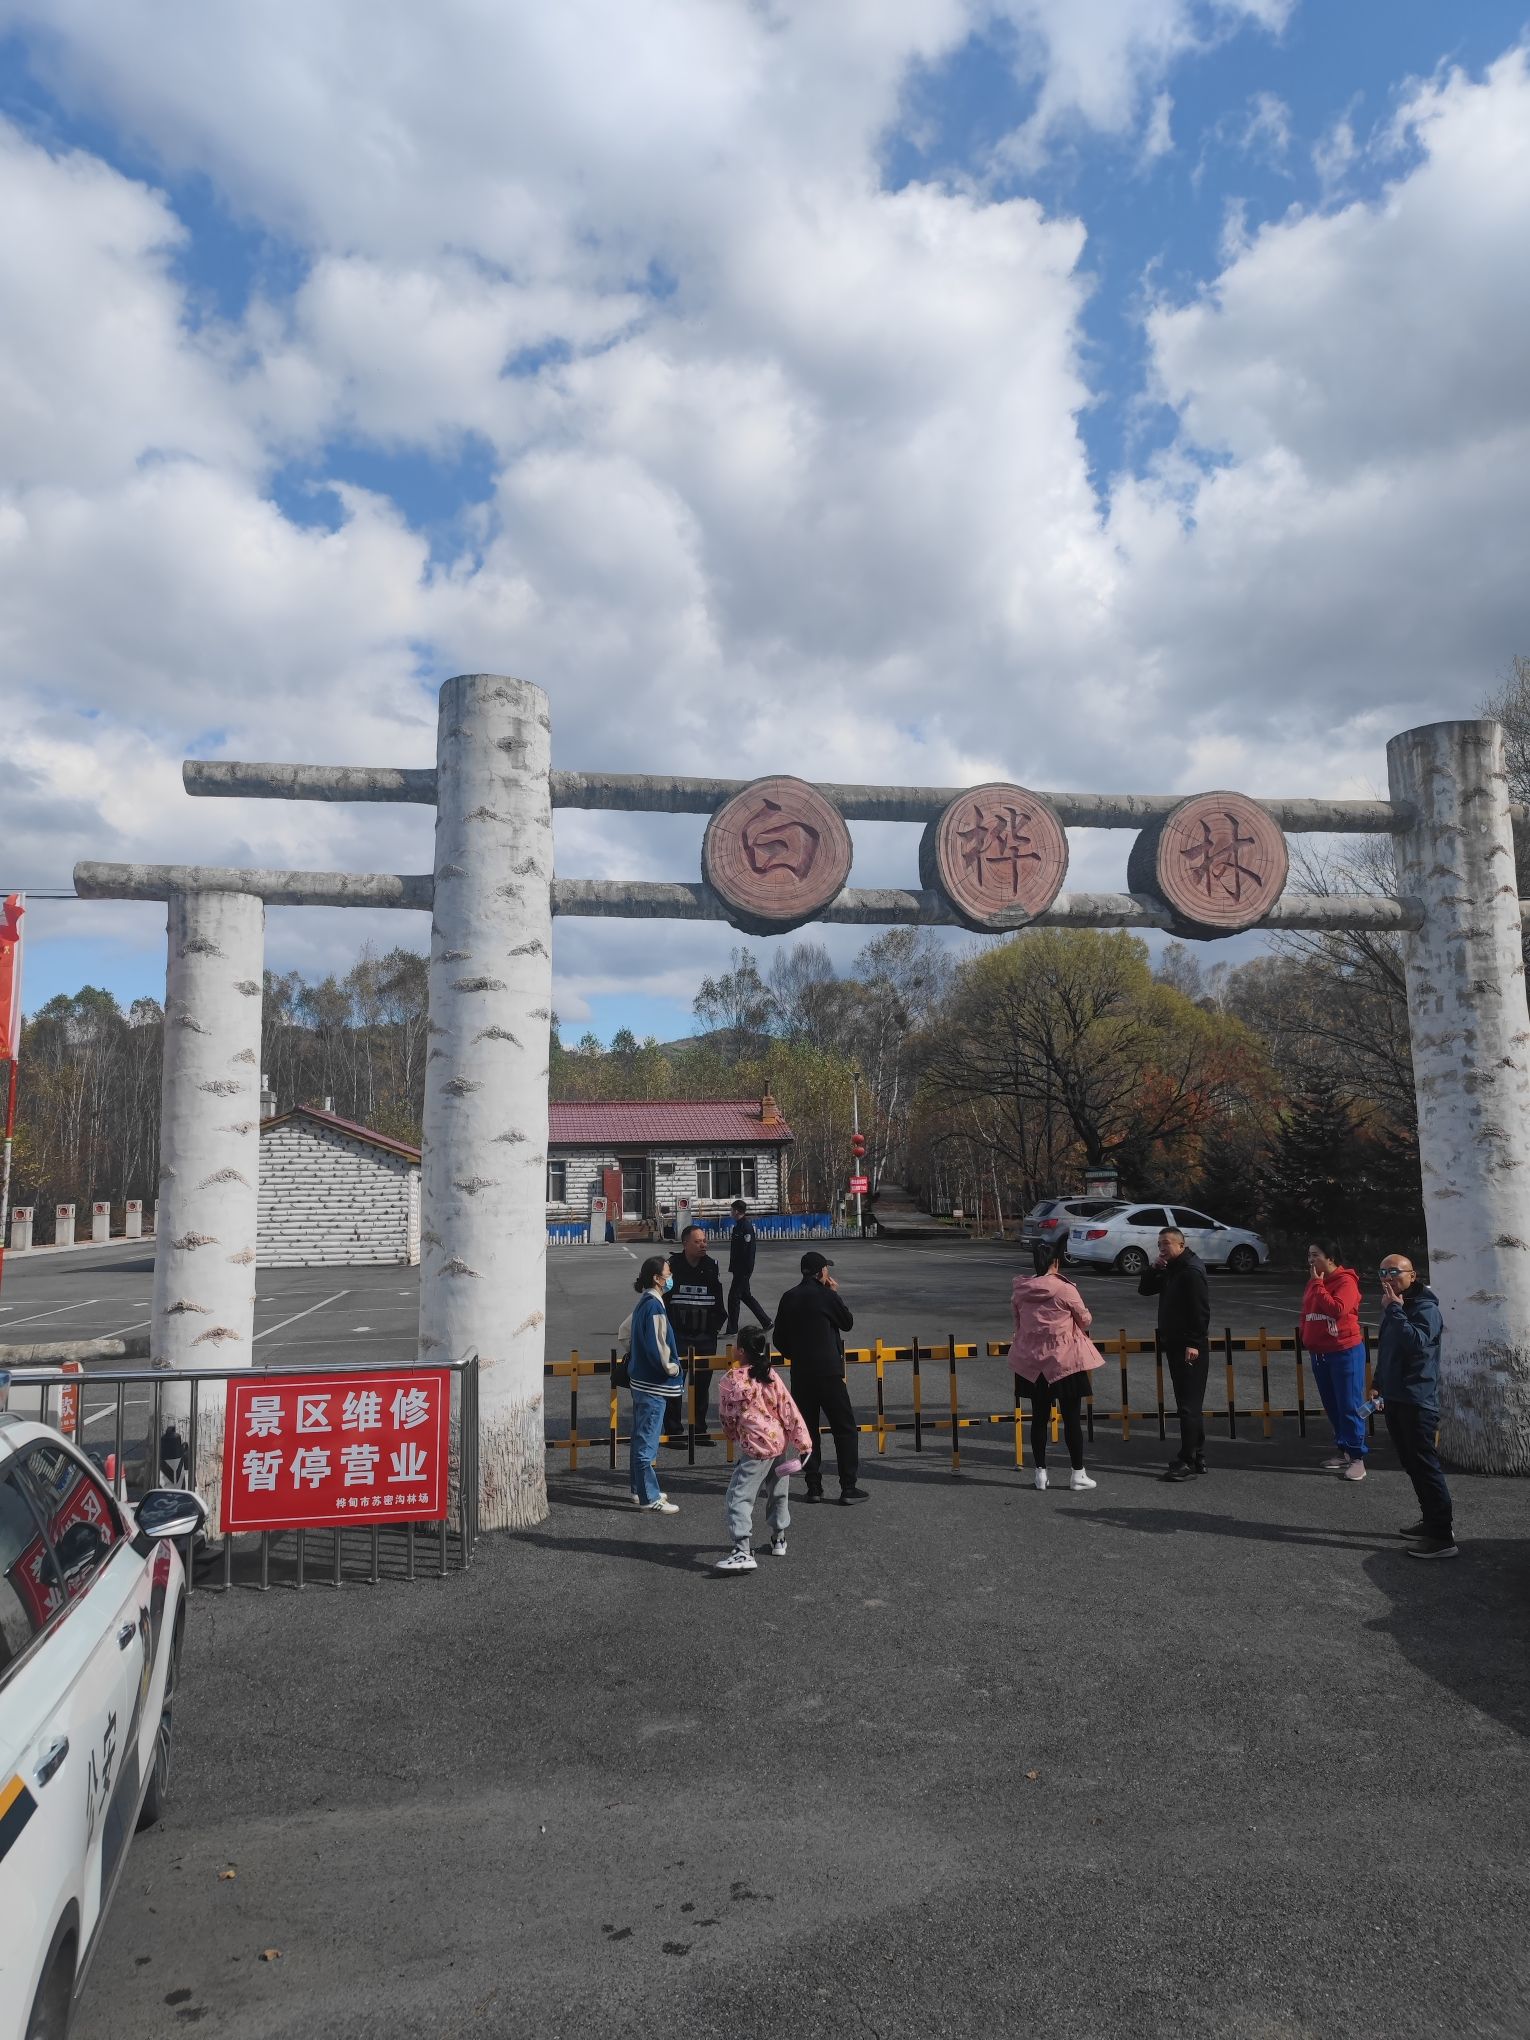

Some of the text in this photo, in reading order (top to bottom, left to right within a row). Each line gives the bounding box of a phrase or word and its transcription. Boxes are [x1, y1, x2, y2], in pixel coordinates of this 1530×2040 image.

[742, 798, 1263, 902] 白桦林
[244, 1387, 430, 1438] 景区维修
[241, 1442, 428, 1493] 暂停营业
[335, 1492, 430, 1509] 桦甸市苏密沟林场
